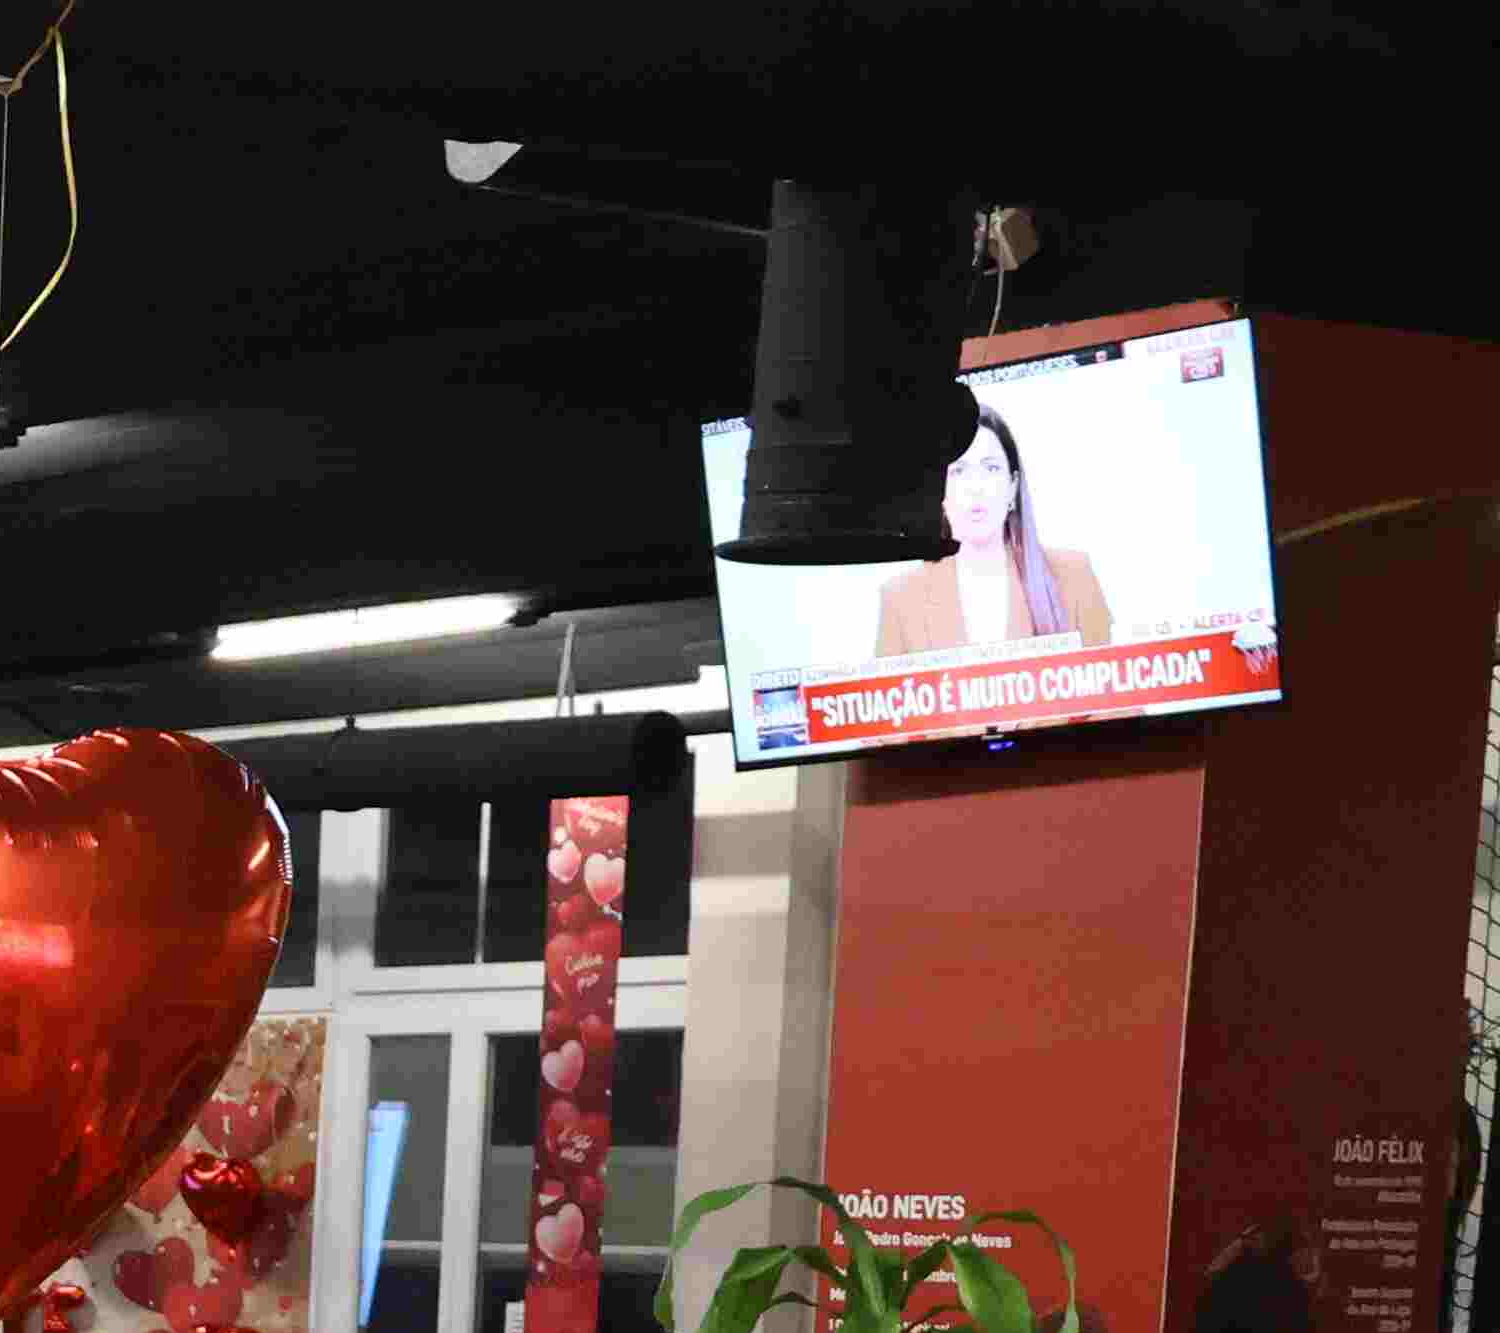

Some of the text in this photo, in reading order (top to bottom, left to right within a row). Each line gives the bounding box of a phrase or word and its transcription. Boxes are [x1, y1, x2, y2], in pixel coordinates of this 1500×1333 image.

[811, 682, 935, 729] "SITUAÇÃO
[940, 677, 956, 712] É
[959, 669, 1037, 708] MUITO
[1039, 649, 1213, 703] COMPLICADA"
[1332, 1131, 1425, 1164] JOÃO FÉLIX
[893, 1194, 966, 1220] NEVES
